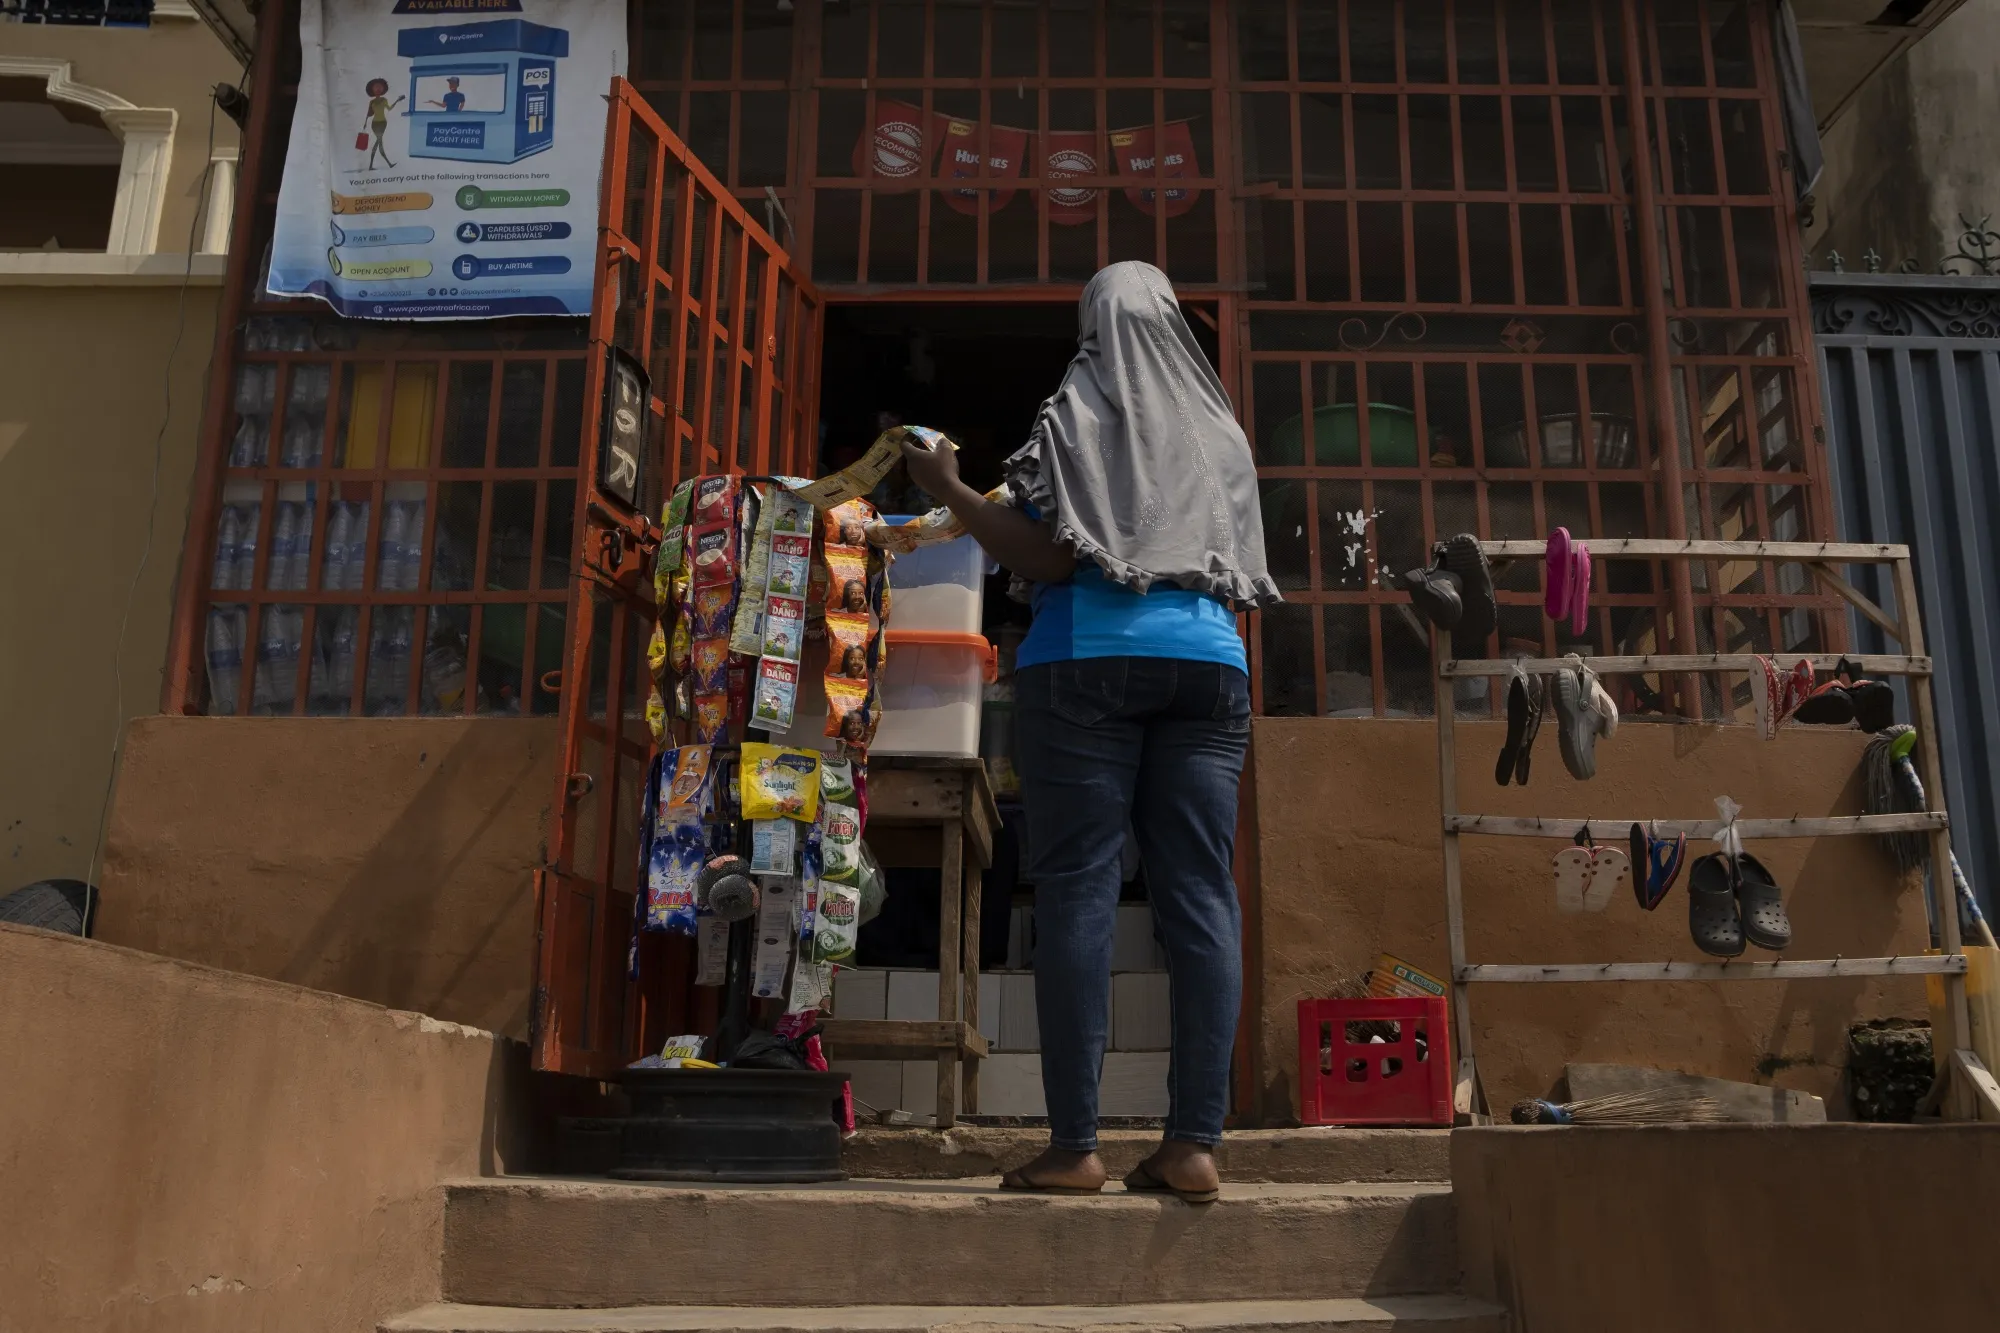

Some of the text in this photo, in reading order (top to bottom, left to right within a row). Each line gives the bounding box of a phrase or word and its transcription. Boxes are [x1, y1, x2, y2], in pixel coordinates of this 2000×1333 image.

[408, 0, 508, 9] AVAILABLE HERE
[525, 71, 548, 80] POS
[433, 126, 481, 136] PayCentre
[432, 135, 480, 145] AGENT HERE
[350, 179, 364, 187] You
[383, 176, 404, 184] carry
[407, 174, 420, 182] out
[422, 173, 435, 181] the
[437, 172, 475, 182] following
[477, 172, 529, 181] transactions
[531, 172, 550, 180] here
[490, 193, 561, 203] WITHDRAW MONEY
[487, 222, 553, 233] CARDLESS (USSD)
[353, 235, 367, 243] PAY
[488, 232, 543, 241] WITHDRAWALS
[350, 265, 411, 276] OPEN ACCOUNT
[488, 261, 534, 271] BUY AIRTIME
[388, 303, 490, 314] www.paycentreafrica.com
[776, 542, 804, 556] DANO
[772, 606, 798, 619] DANO
[766, 668, 792, 681] DANO
[764, 779, 796, 791] Sunlight
